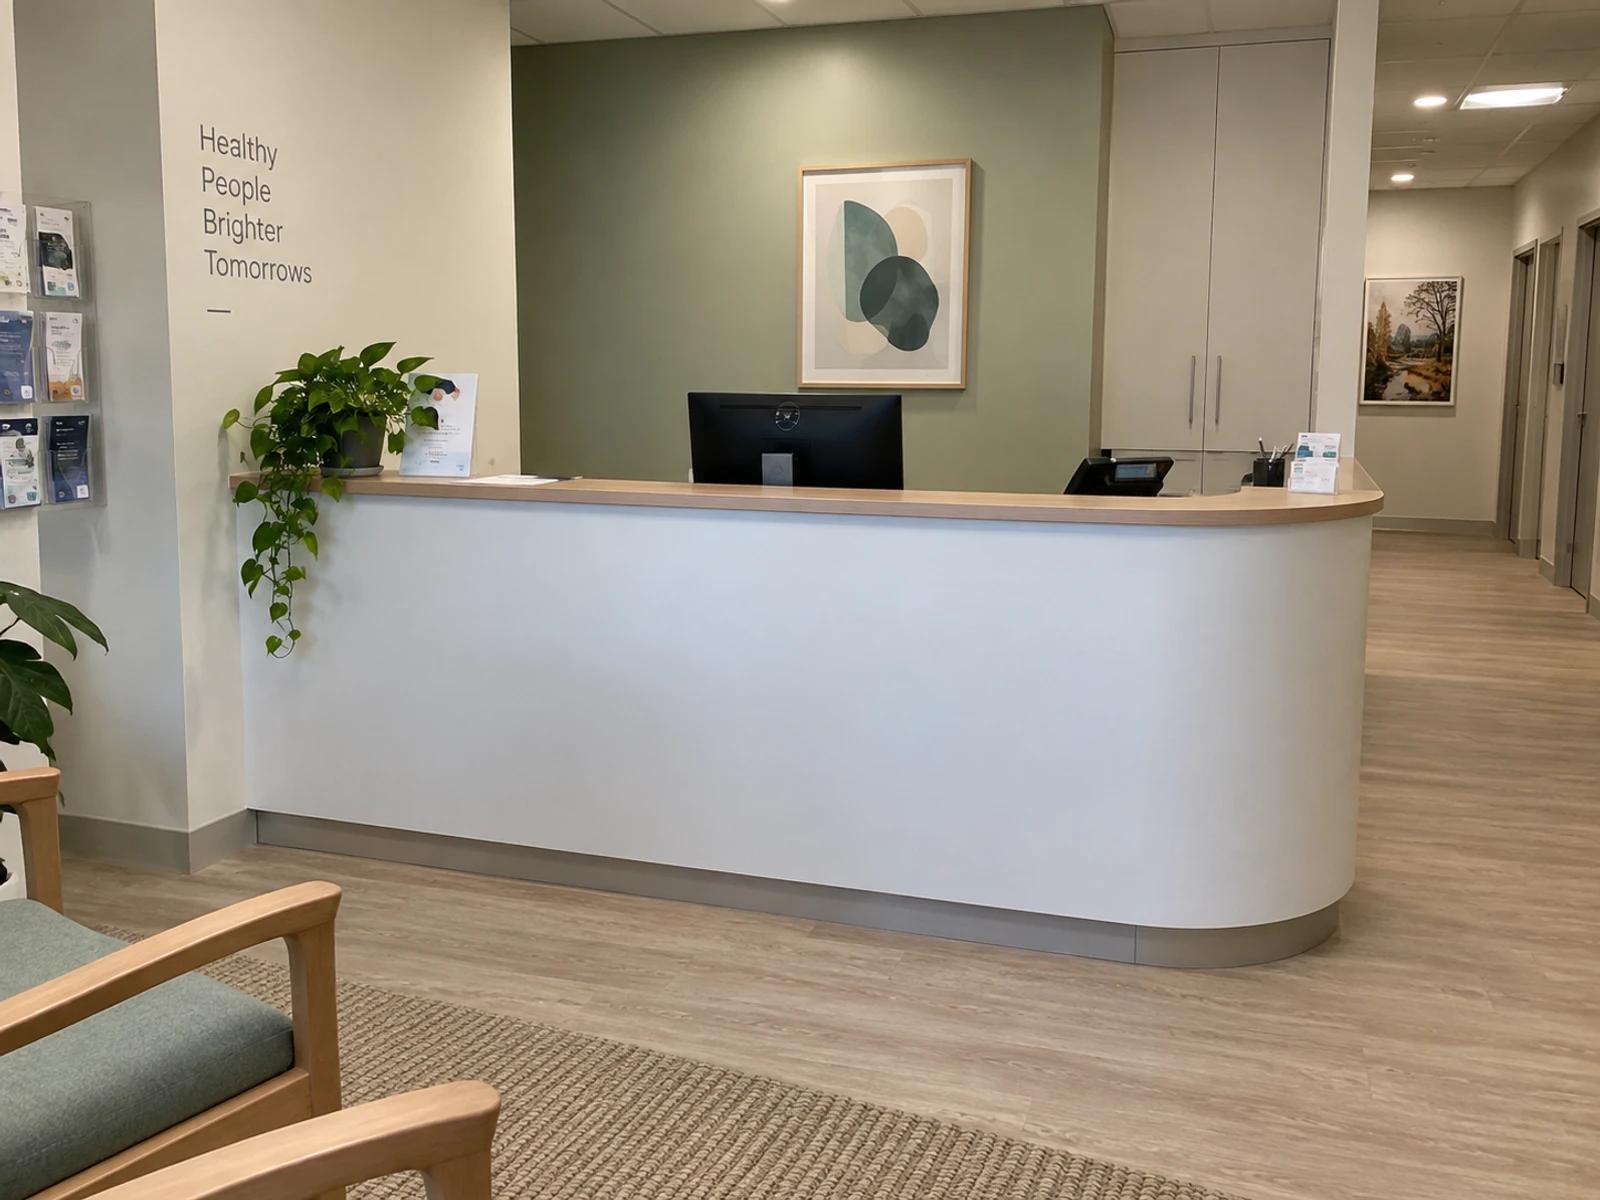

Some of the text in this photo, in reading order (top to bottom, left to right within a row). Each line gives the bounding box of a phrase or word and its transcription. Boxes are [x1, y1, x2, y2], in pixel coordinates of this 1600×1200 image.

[200, 124, 278, 171] Healthy
[202, 166, 271, 206] People
[203, 207, 284, 245] Brighter
[203, 248, 313, 284] Tomorrows
